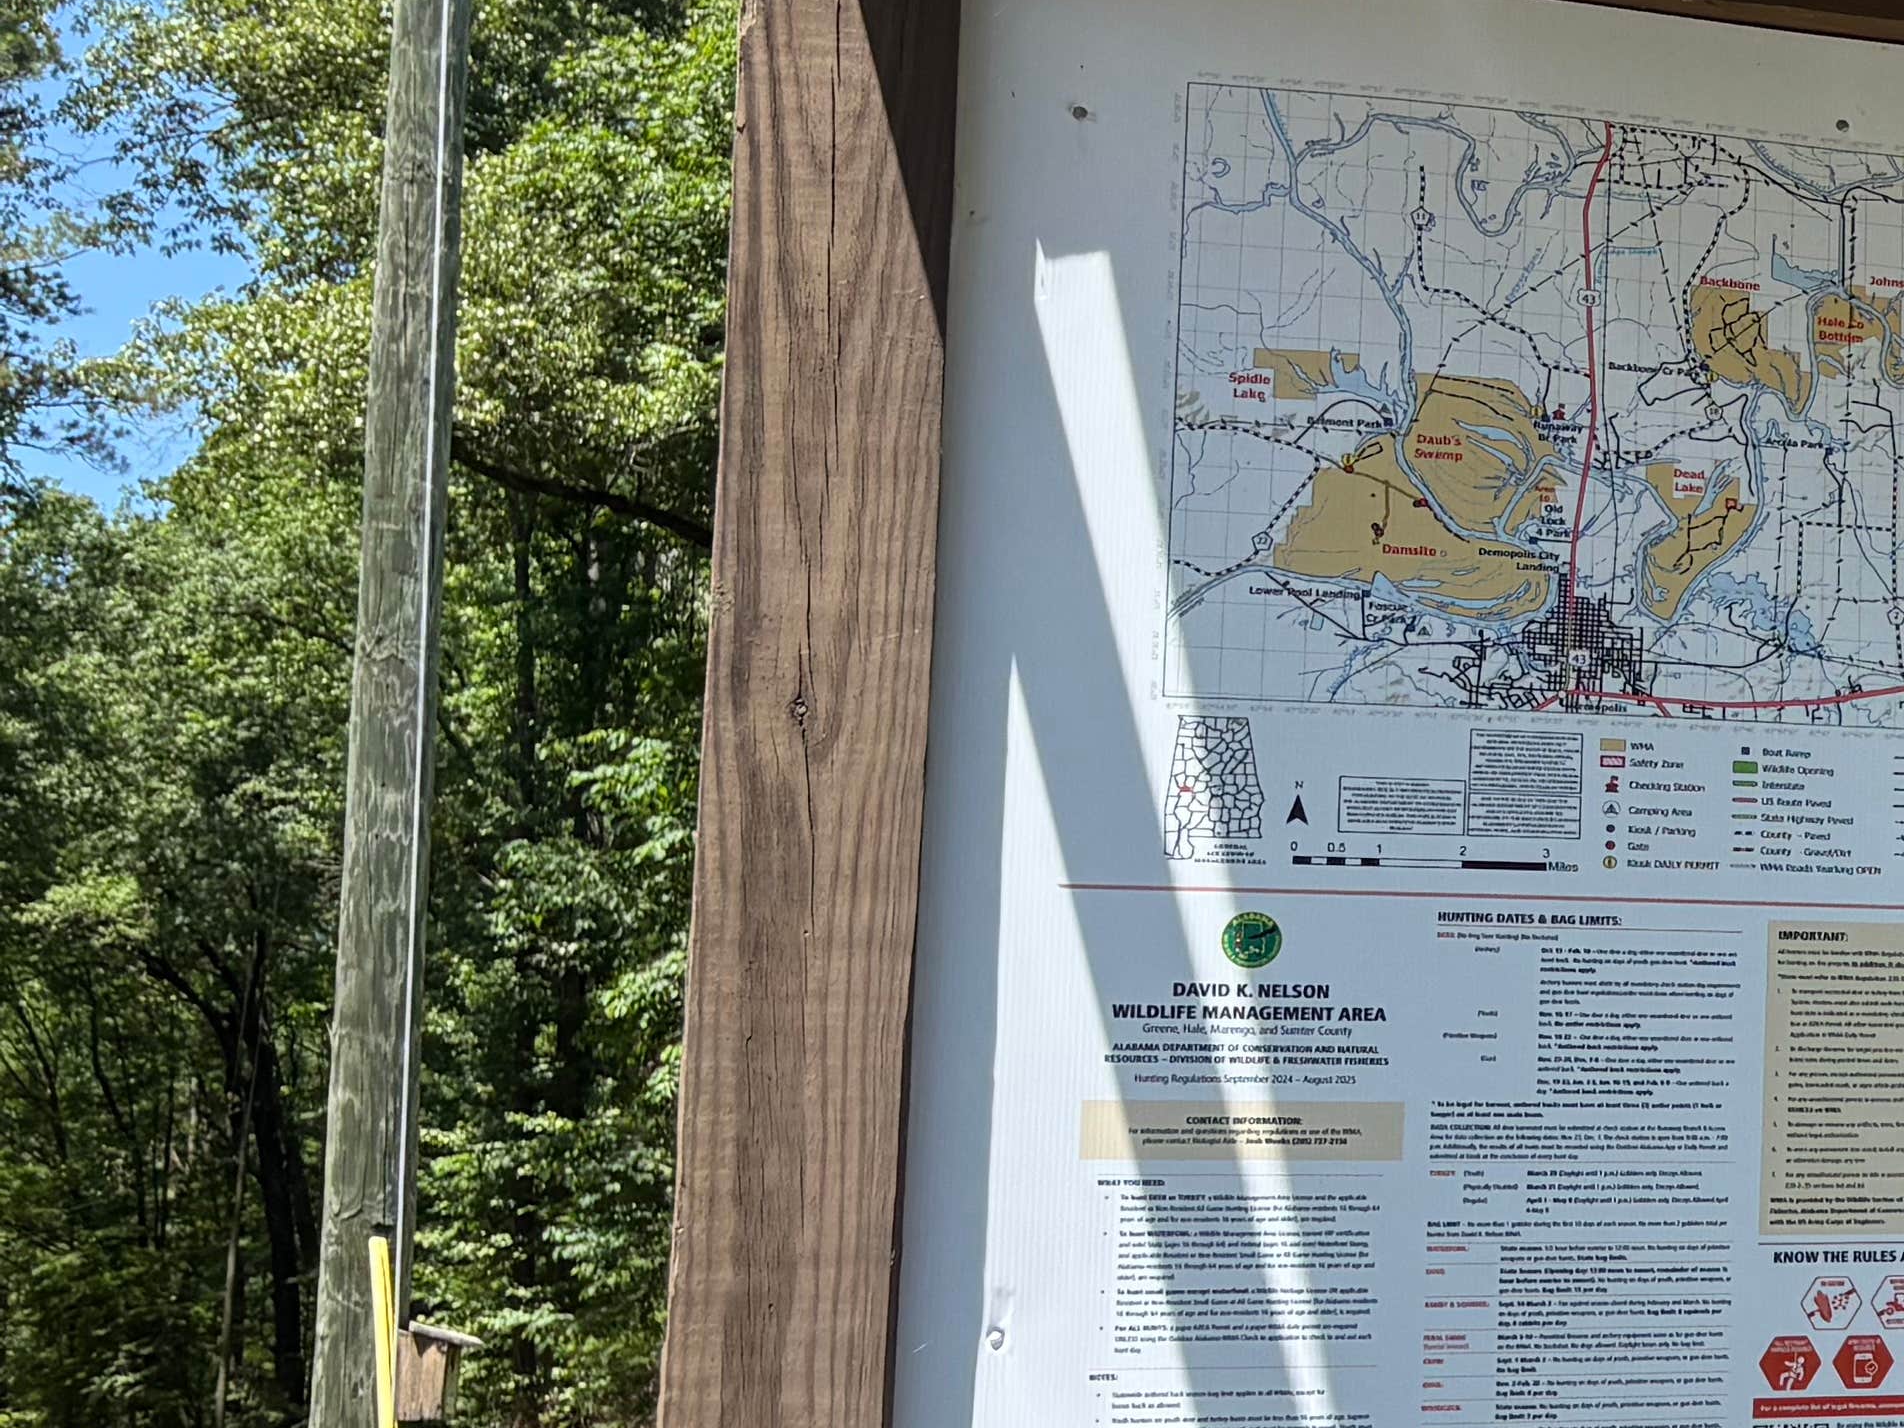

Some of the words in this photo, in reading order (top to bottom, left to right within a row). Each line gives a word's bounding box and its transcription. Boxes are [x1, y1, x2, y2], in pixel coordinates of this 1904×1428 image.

[1700, 276, 1761, 291] Backbone
[1581, 294, 1596, 304] 43
[1233, 388, 1266, 400] Lake
[1674, 481, 1704, 494] Lake
[1437, 911, 1493, 923] HUNTING
[1496, 913, 1535, 924] DATES
[1537, 914, 1547, 924] &
[1550, 914, 1576, 925] BAG
[1578, 915, 1622, 926] LIMITS:
[1173, 982, 1230, 997] DAVID
[1236, 983, 1253, 998] K.
[1257, 984, 1329, 999] NELSON
[1112, 1004, 1197, 1019] WILDLIFE
[1202, 1005, 1335, 1021] MANAGEMENT
[1337, 1007, 1386, 1021] AREA
[1773, 1251, 1819, 1263] KNOW
[1822, 1250, 1849, 1263] THE
[1853, 1250, 1897, 1263] RULES
